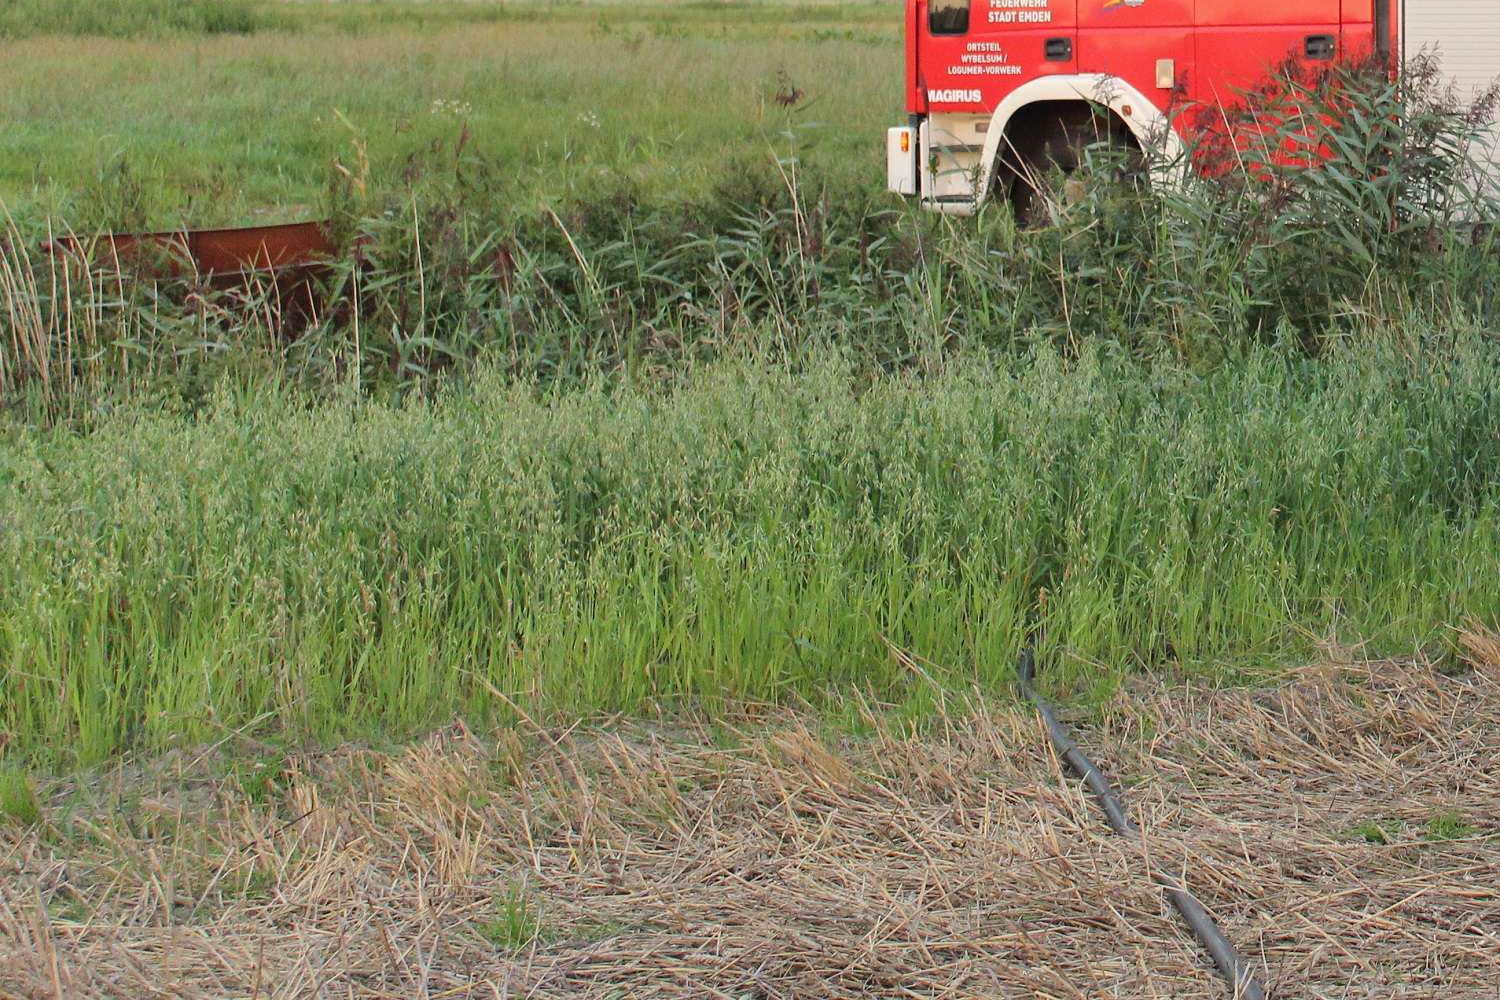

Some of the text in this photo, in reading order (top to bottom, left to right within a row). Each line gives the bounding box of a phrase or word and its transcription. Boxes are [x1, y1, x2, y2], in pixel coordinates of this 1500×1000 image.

[988, 11, 1051, 22] STADT EMDEN
[966, 42, 1001, 52] ORTSTEIL
[961, 54, 1003, 63] WYBELSUM
[947, 66, 1022, 74] LOGUMER-VORWERK
[927, 89, 982, 102] MAGIRUS
